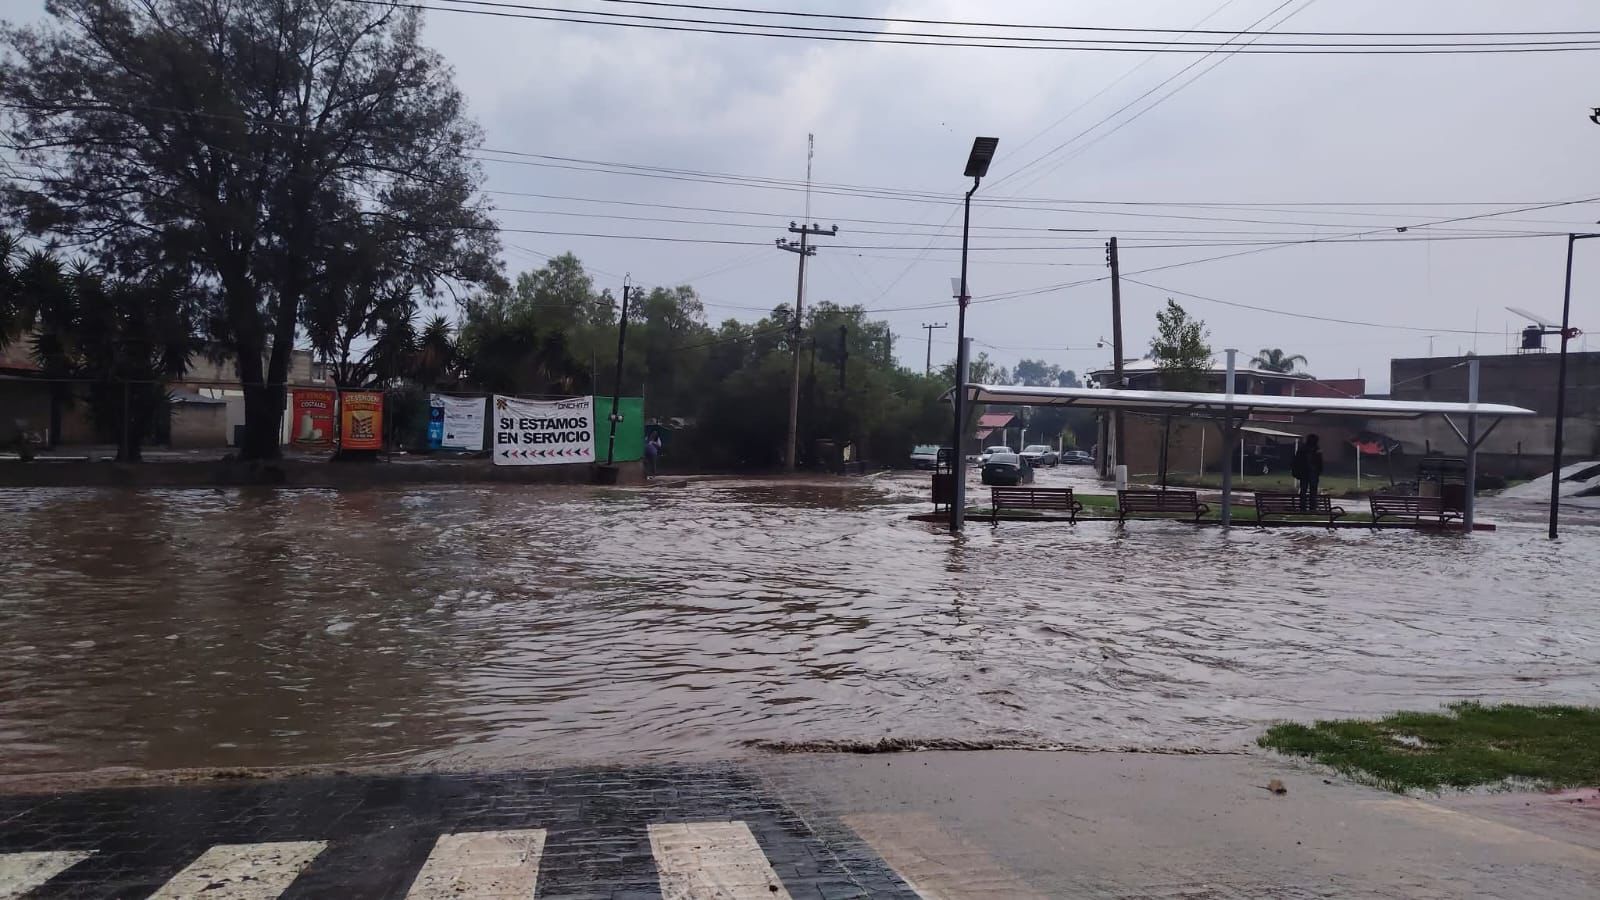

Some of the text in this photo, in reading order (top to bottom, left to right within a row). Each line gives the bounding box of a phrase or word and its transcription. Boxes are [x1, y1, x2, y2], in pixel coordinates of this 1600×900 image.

[500, 417, 588, 430] SI ESTAMOS
[498, 431, 591, 444] EN SERVICIO
